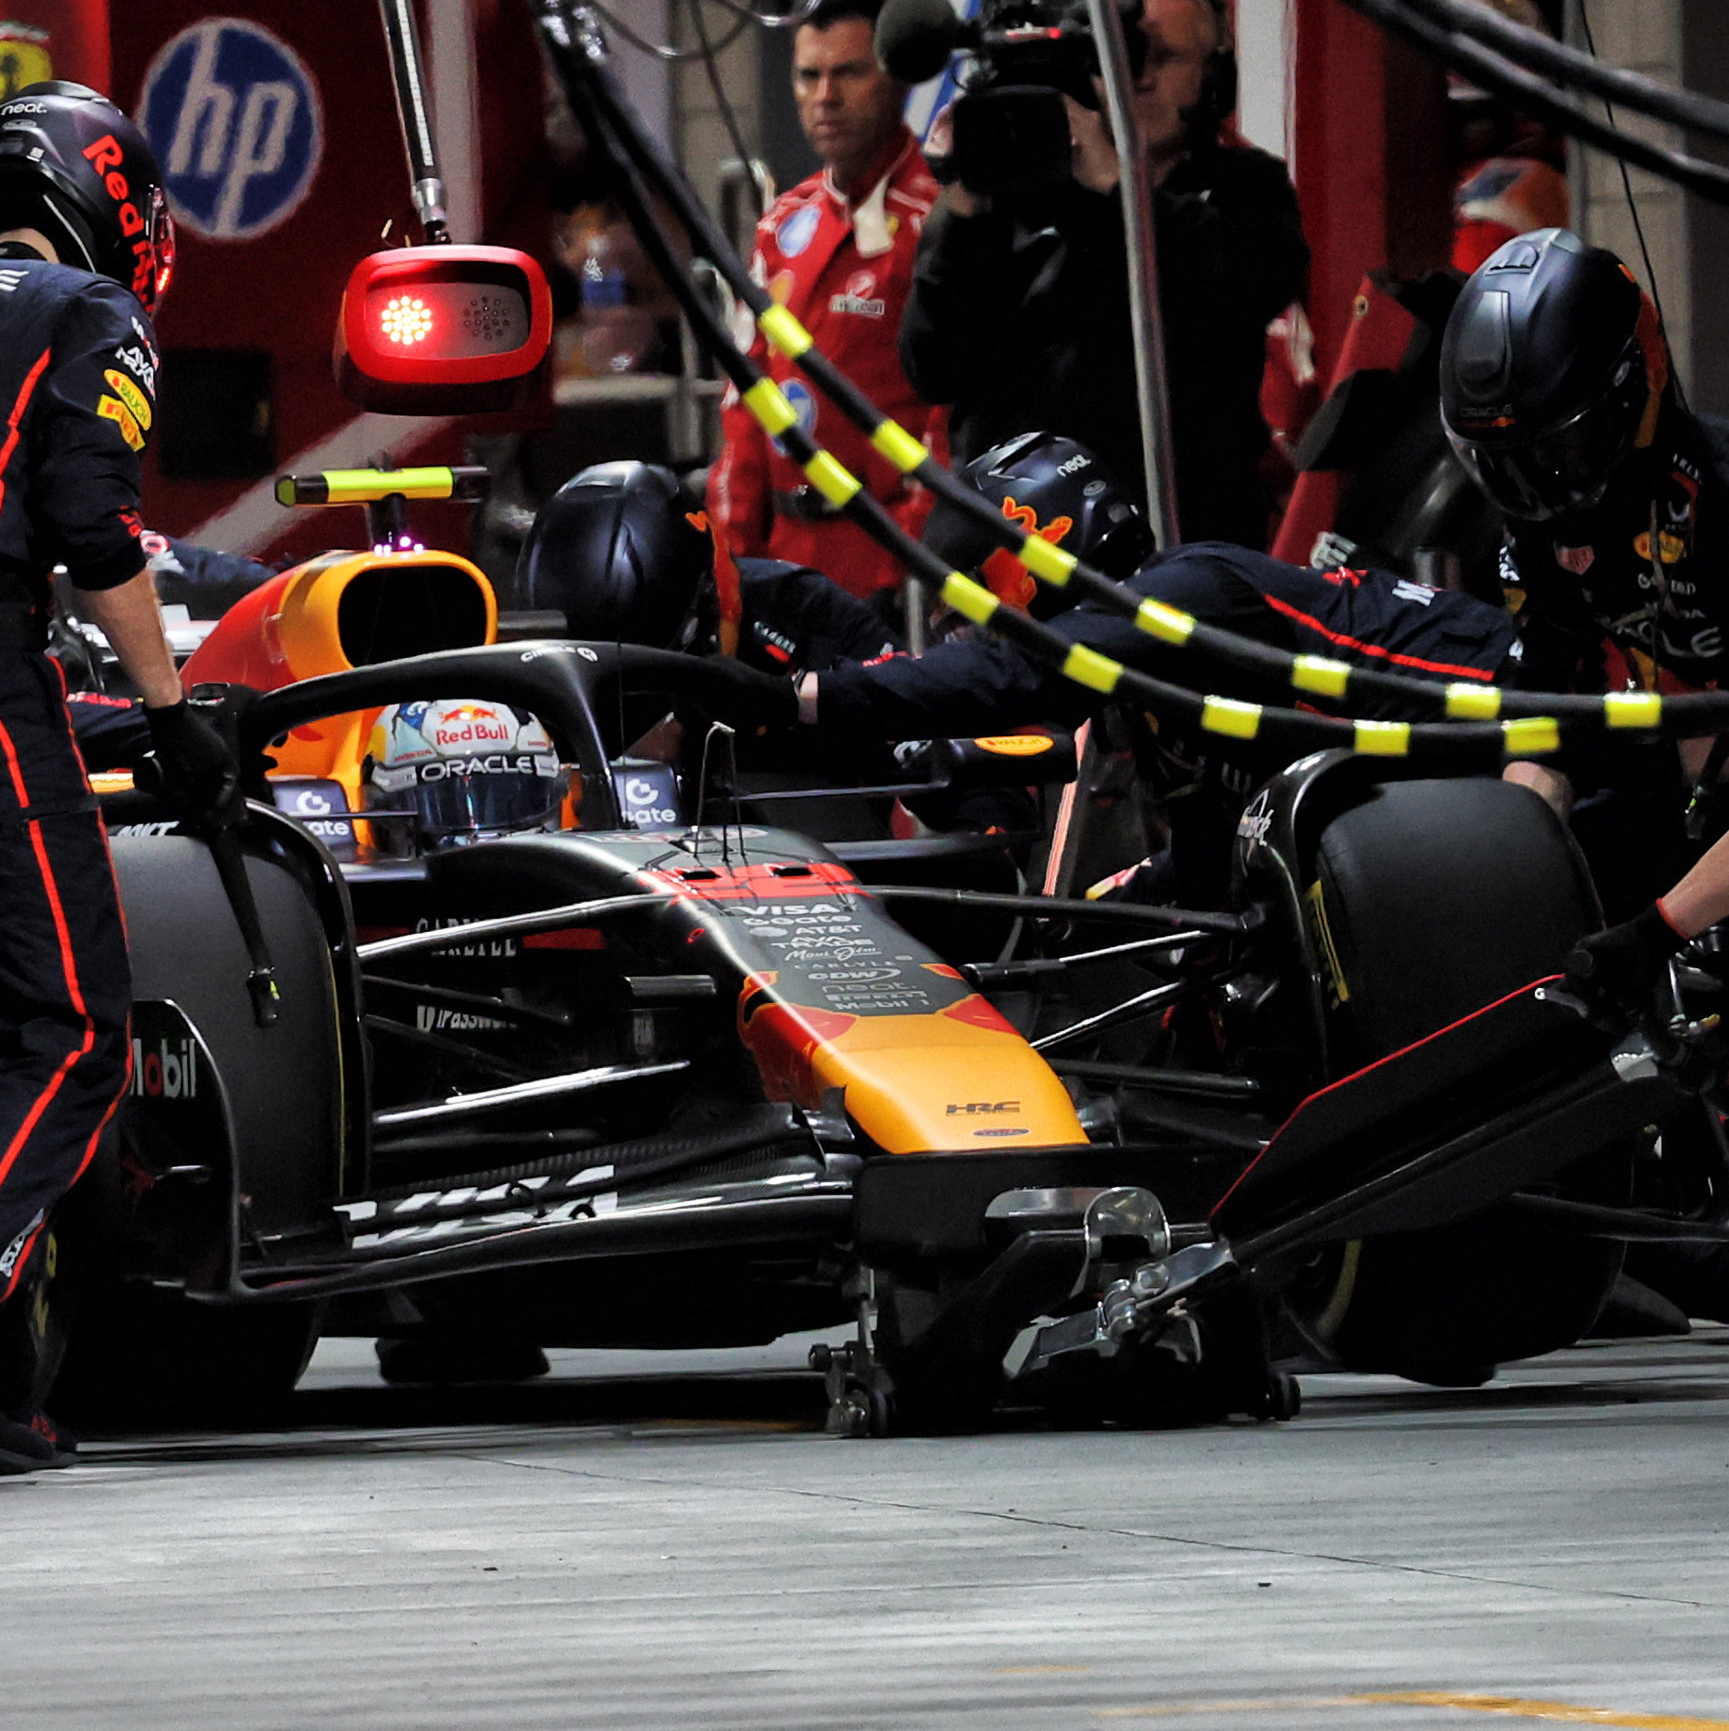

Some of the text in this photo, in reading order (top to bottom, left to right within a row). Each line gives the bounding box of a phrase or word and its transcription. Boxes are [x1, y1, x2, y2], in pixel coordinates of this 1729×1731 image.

[0, 101, 48, 116] neat.
[171, 19, 296, 238] hp
[81, 135, 145, 237] Red
[436, 723, 510, 746] Red Bull
[421, 754, 534, 782] ORACLE
[303, 821, 350, 837] ate
[730, 903, 841, 916] VISA
[795, 924, 862, 935] AT&T
[822, 981, 917, 993] neat.
[834, 1000, 909, 1011] Mobil
